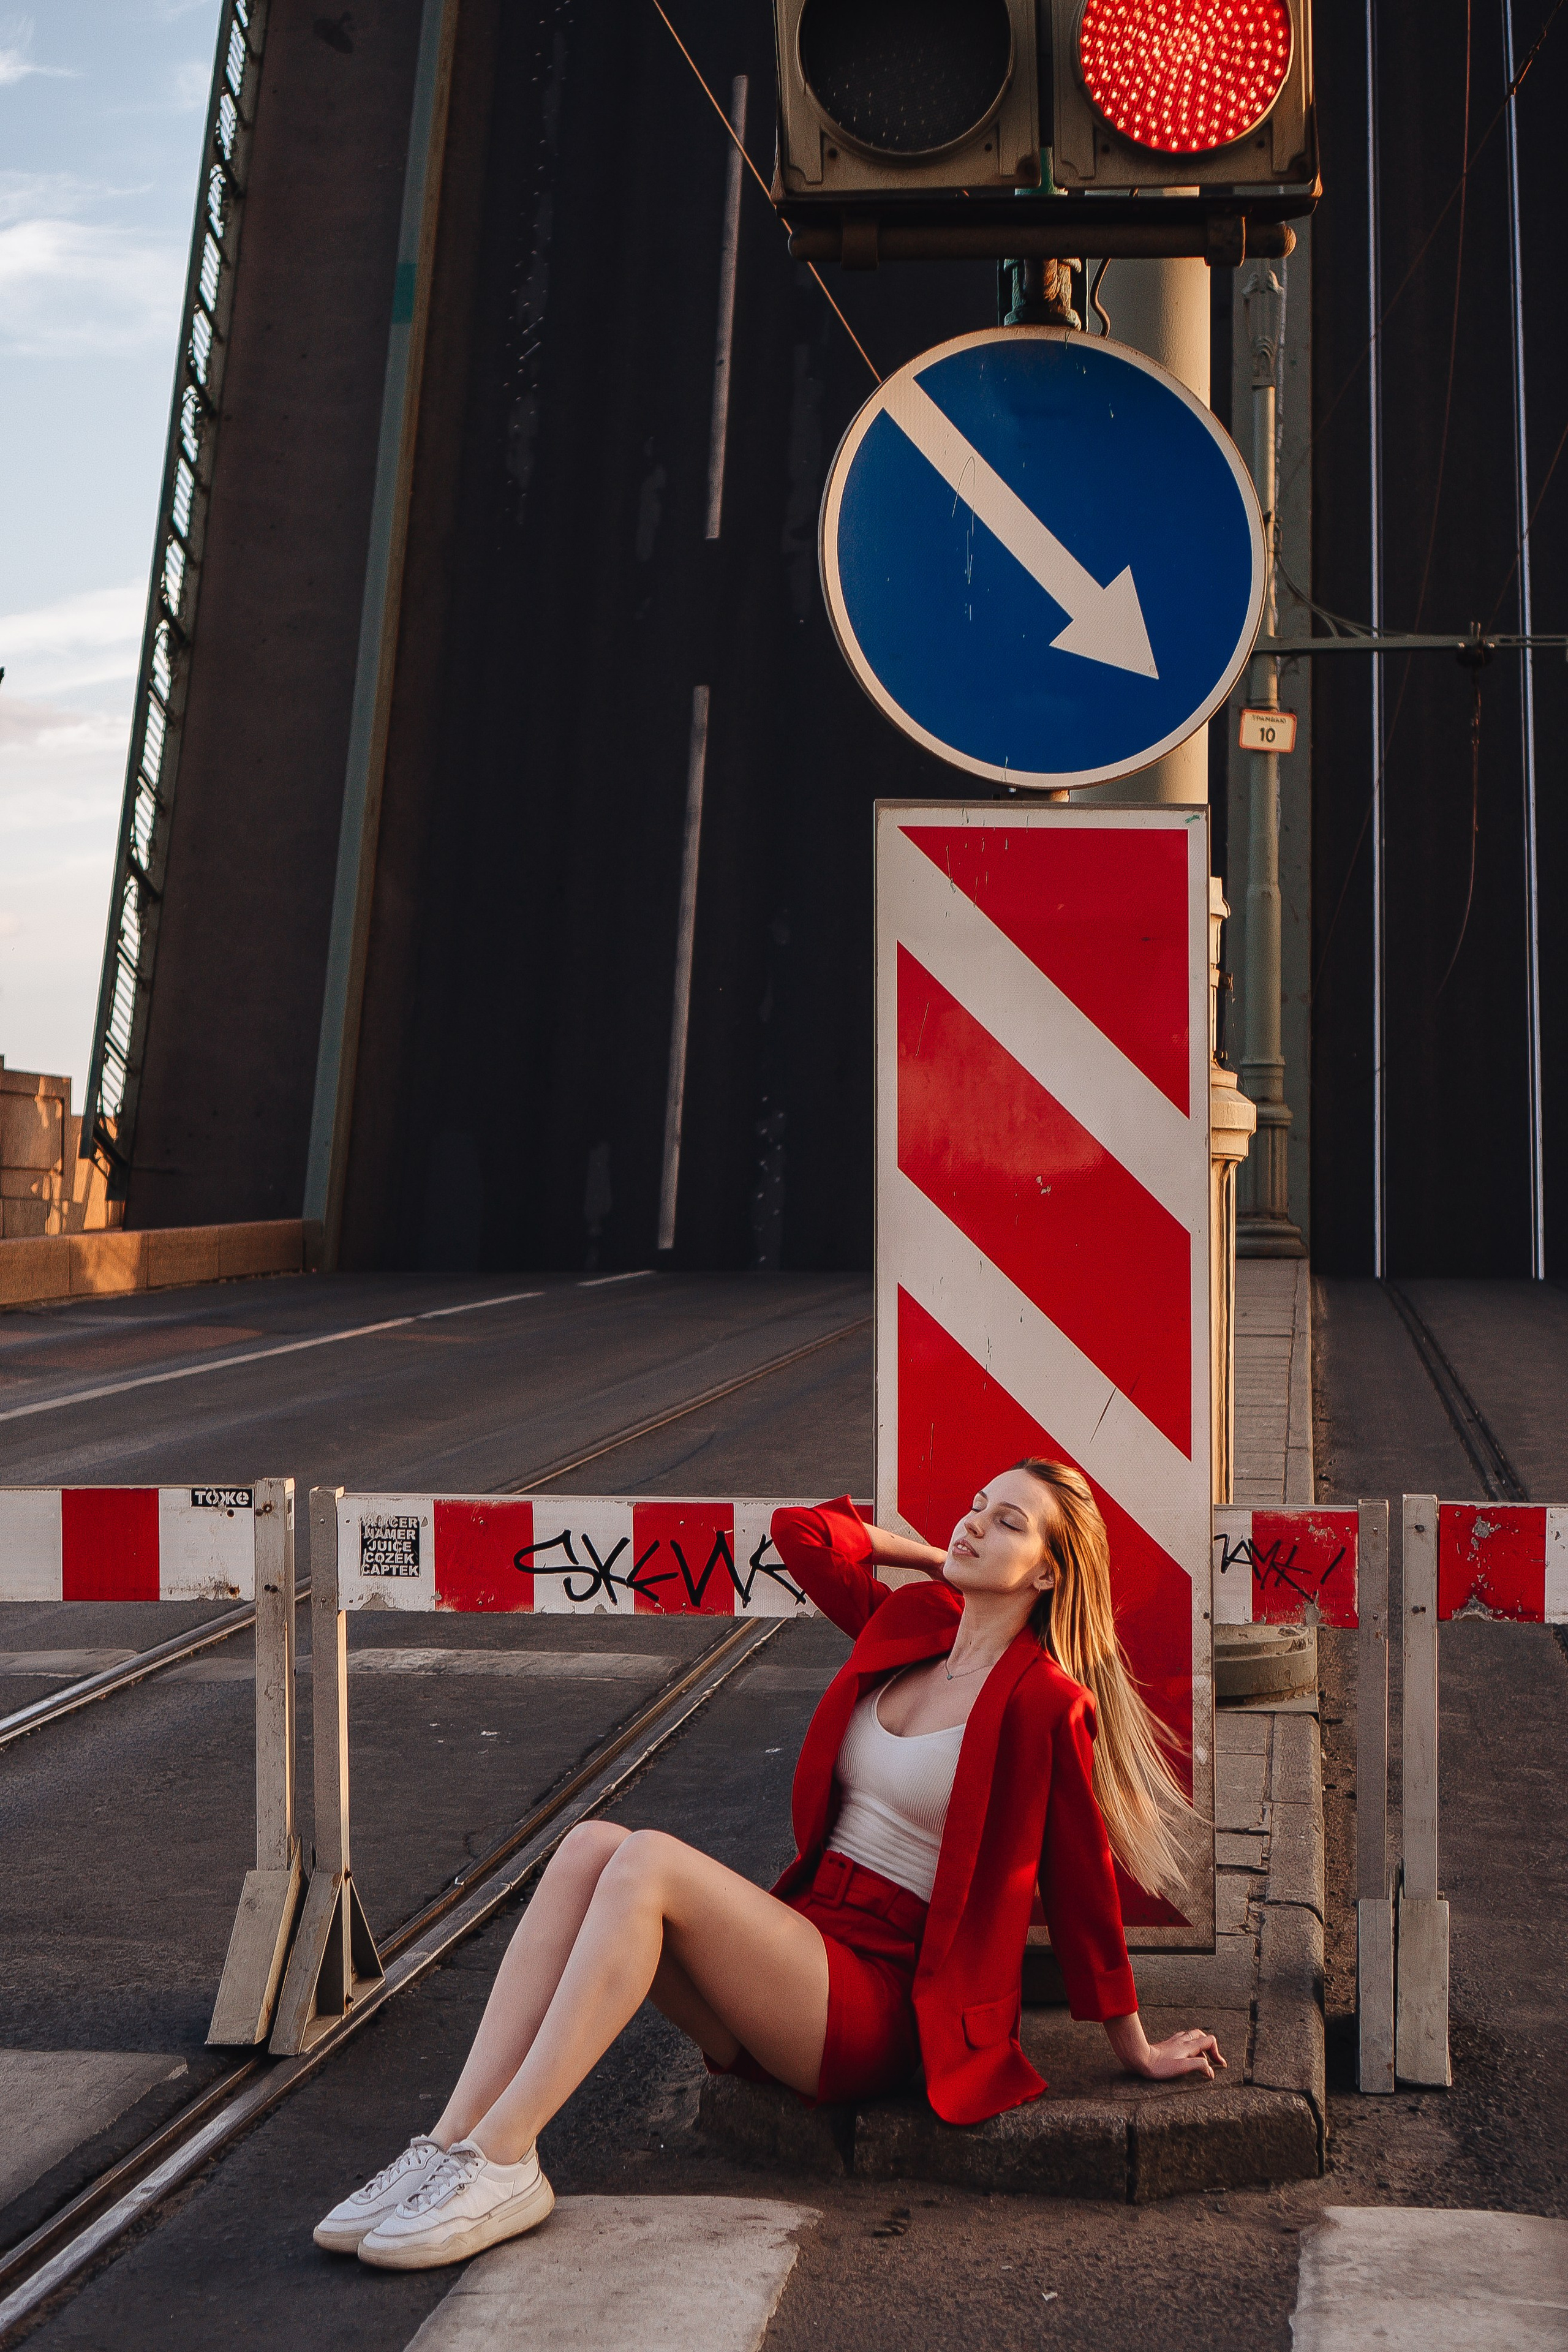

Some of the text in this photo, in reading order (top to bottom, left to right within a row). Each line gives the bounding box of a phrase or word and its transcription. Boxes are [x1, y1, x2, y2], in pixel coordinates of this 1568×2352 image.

[1260, 727, 1276, 743] 10
[368, 1540, 412, 1552] JUICE
[365, 1553, 414, 1564] COZEK
[361, 1564, 419, 1576] CAPTEK
